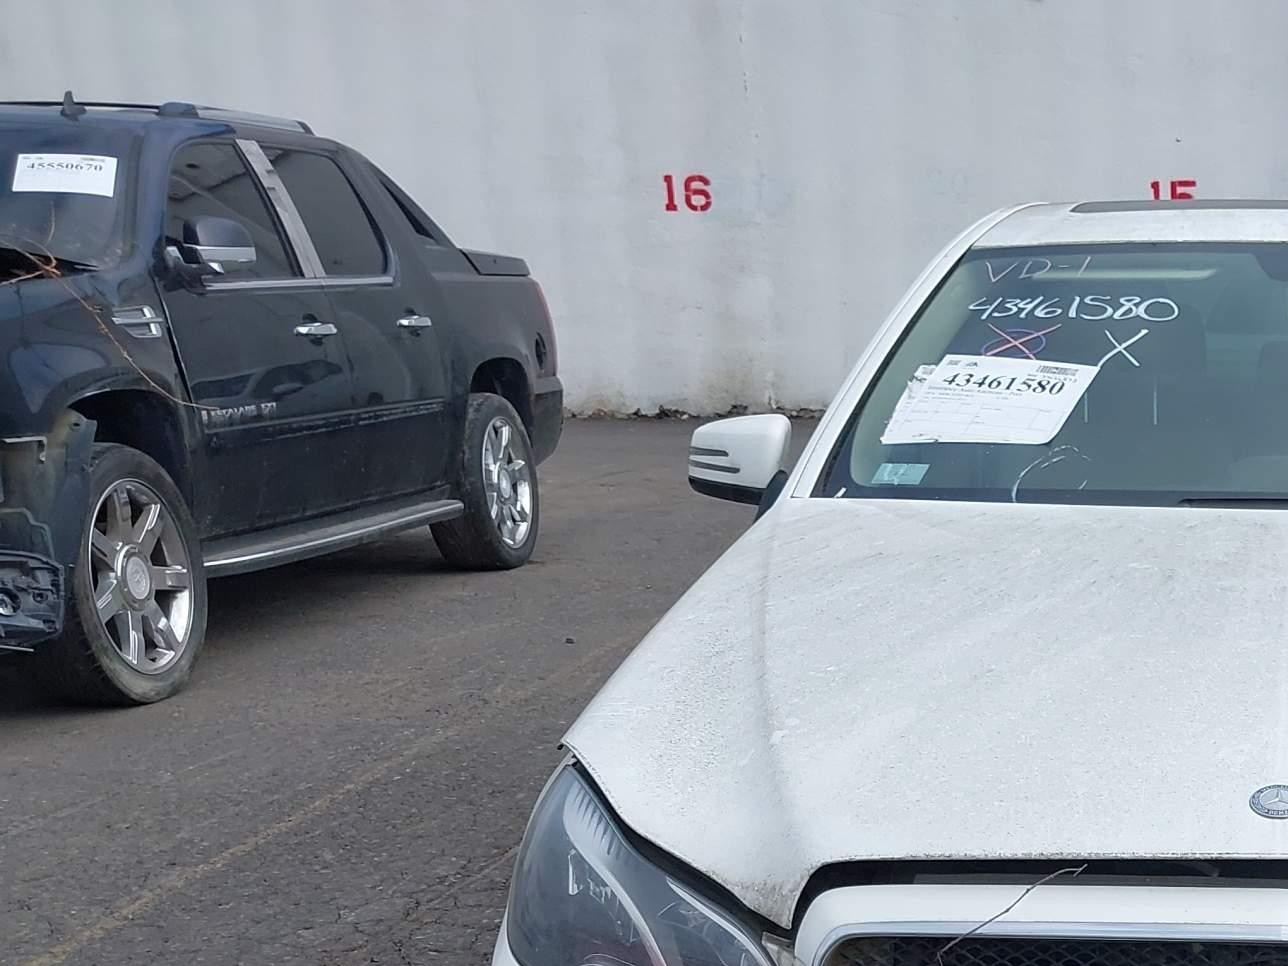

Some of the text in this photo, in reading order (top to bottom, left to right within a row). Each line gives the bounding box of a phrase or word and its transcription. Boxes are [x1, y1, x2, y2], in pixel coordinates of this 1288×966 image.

[663, 174, 714, 212] 16
[968, 295, 1180, 321] 43461580
[943, 372, 1066, 396] 43461580
